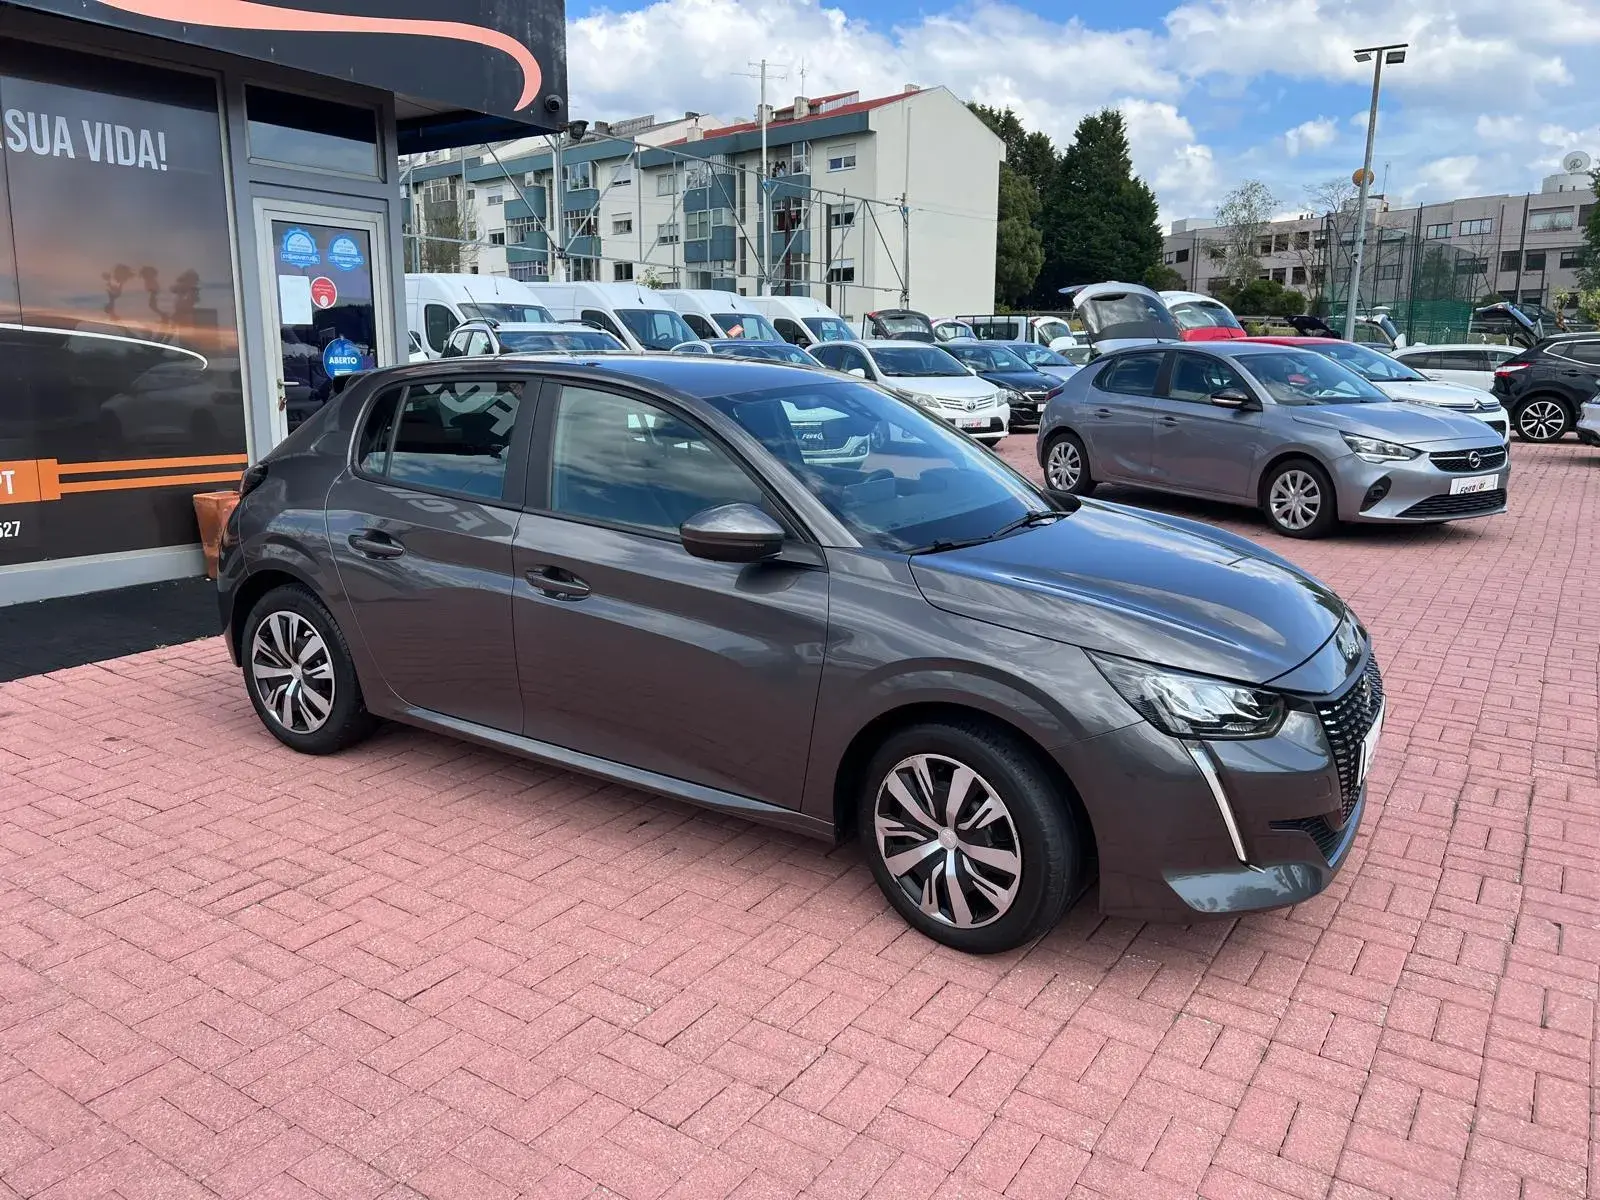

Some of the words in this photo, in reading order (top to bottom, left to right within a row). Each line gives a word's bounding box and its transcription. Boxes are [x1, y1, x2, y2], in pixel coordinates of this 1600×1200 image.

[4, 108, 76, 159] SUA
[81, 119, 168, 172] VIDA!
[328, 356, 358, 365] ABERTO
[0, 470, 15, 495] T
